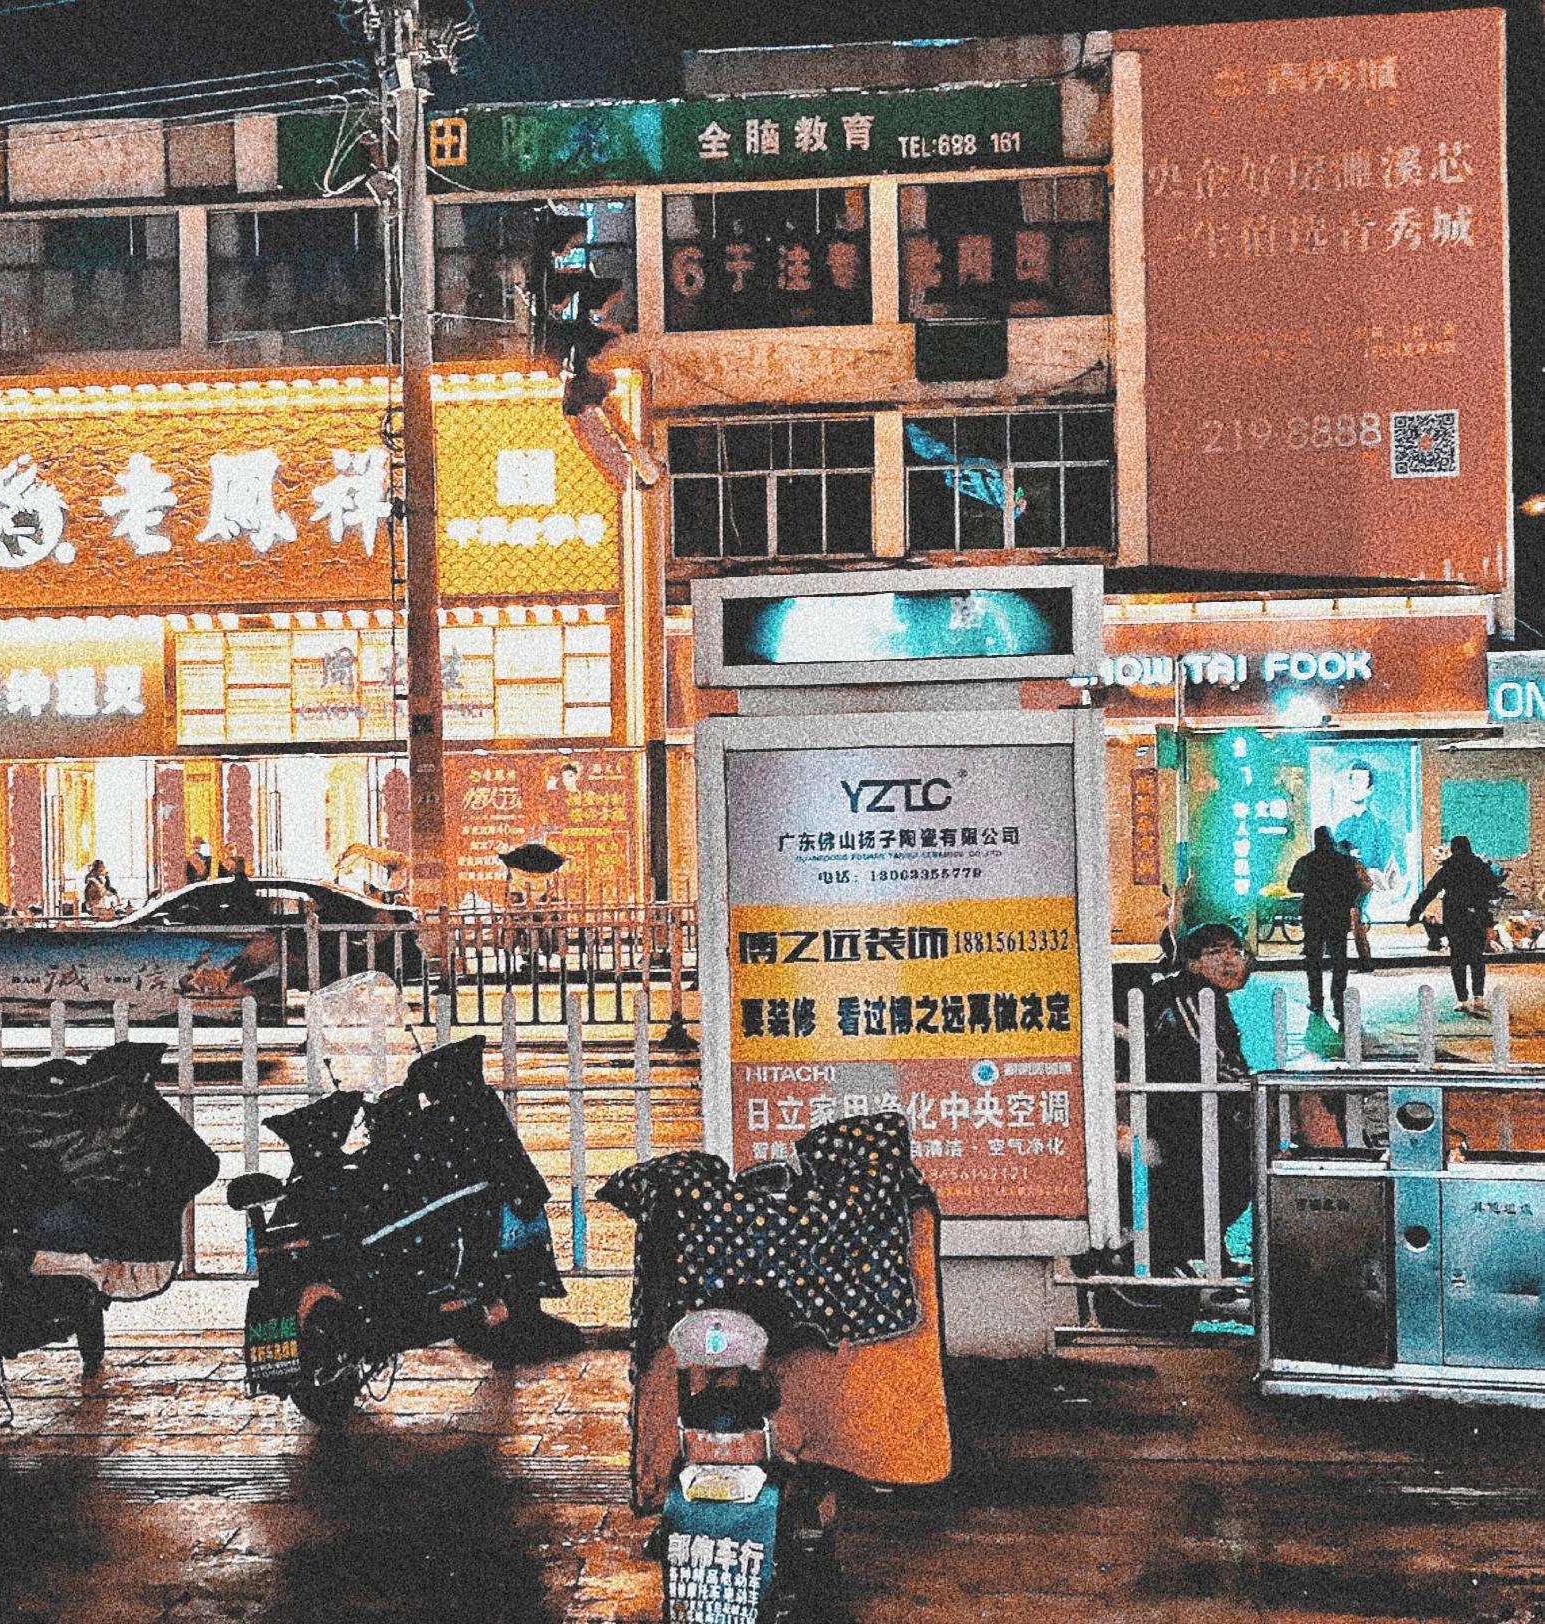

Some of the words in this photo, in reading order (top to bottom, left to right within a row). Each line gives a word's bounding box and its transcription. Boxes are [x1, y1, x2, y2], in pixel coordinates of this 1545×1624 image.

[697, 111, 875, 160] 全脑教育
[897, 133, 977, 160] TEL:688
[990, 131, 1022, 154] 161
[1202, 417, 1273, 454] 219
[1286, 411, 1382, 450] 8888
[1181, 652, 1248, 686] TAI
[1261, 650, 1374, 684] FOOK
[777, 825, 1021, 853] 广东佛山扬子陶瓷有限公司
[738, 926, 949, 965] 博之远装饰
[953, 928, 1070, 954] 18815613332
[740, 995, 817, 1038] 要装修
[835, 990, 1072, 1037] 看过博之远再做决定
[745, 1065, 836, 1083] HITACHI
[986, 1136, 1067, 1157] 空气净化
